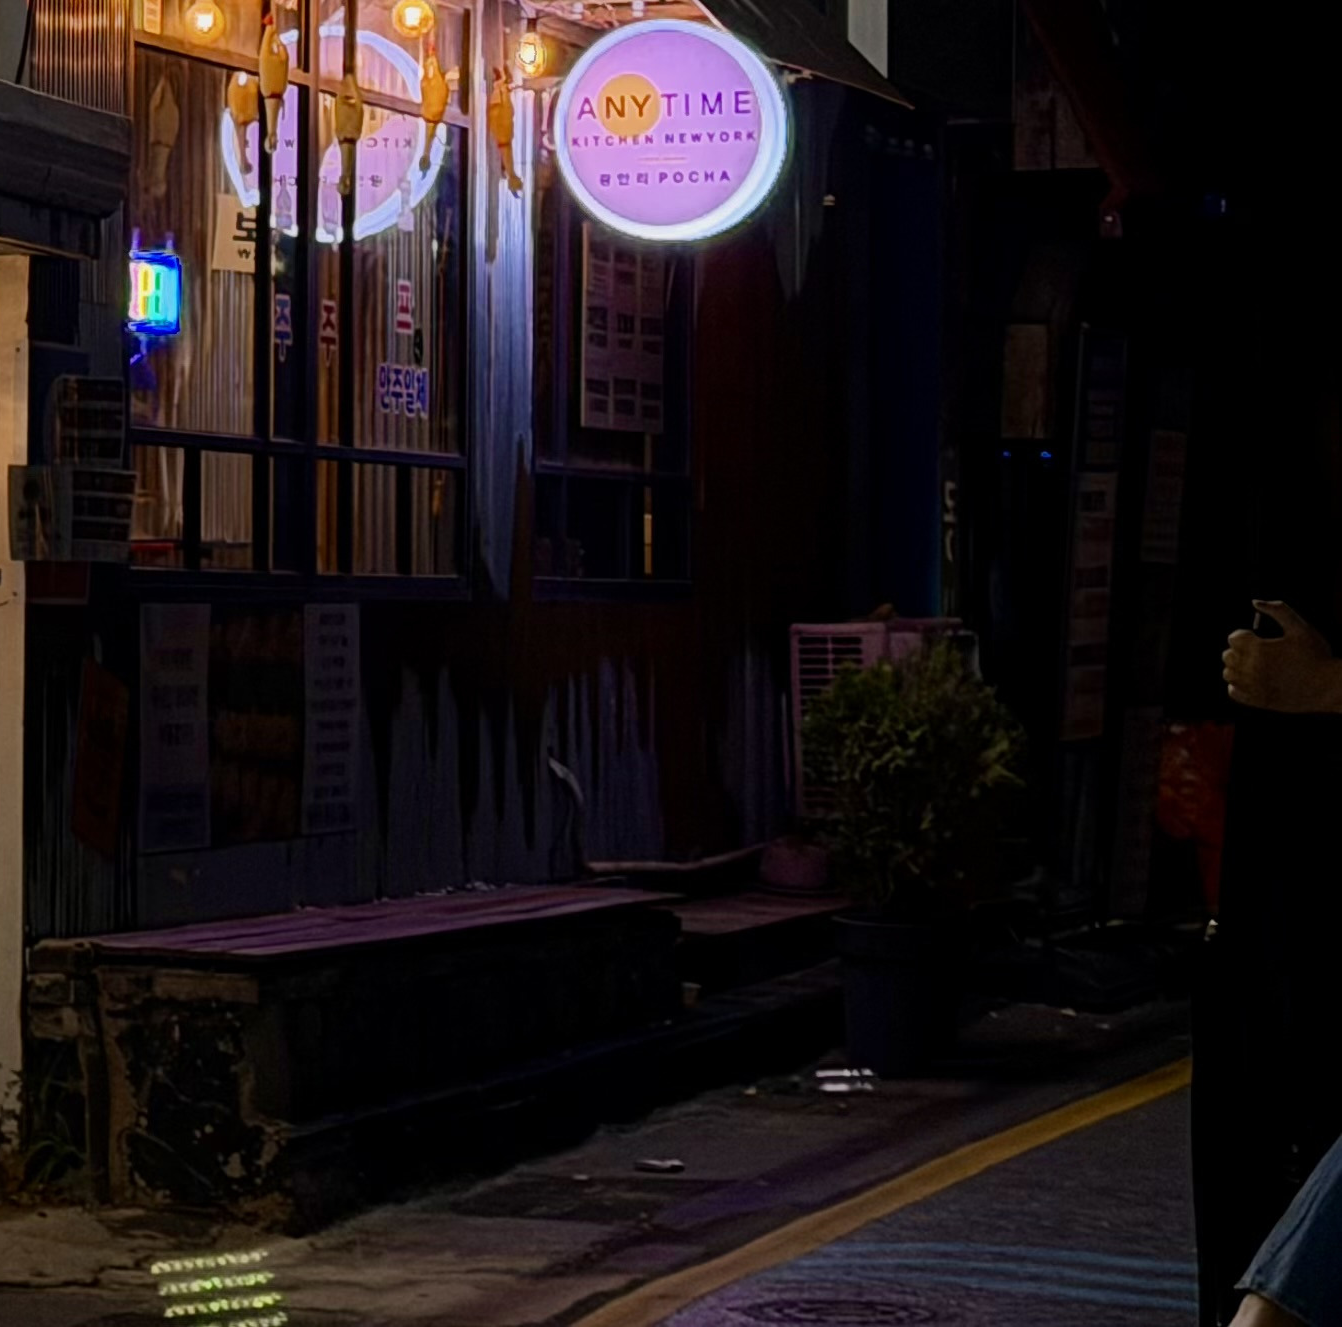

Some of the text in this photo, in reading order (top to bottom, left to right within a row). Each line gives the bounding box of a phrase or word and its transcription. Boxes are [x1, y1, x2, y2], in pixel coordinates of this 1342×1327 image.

[577, 90, 752, 120] ANYTIME
[572, 130, 757, 148] KITCHEN NEWYORK
[658, 169, 731, 185] POCHA
